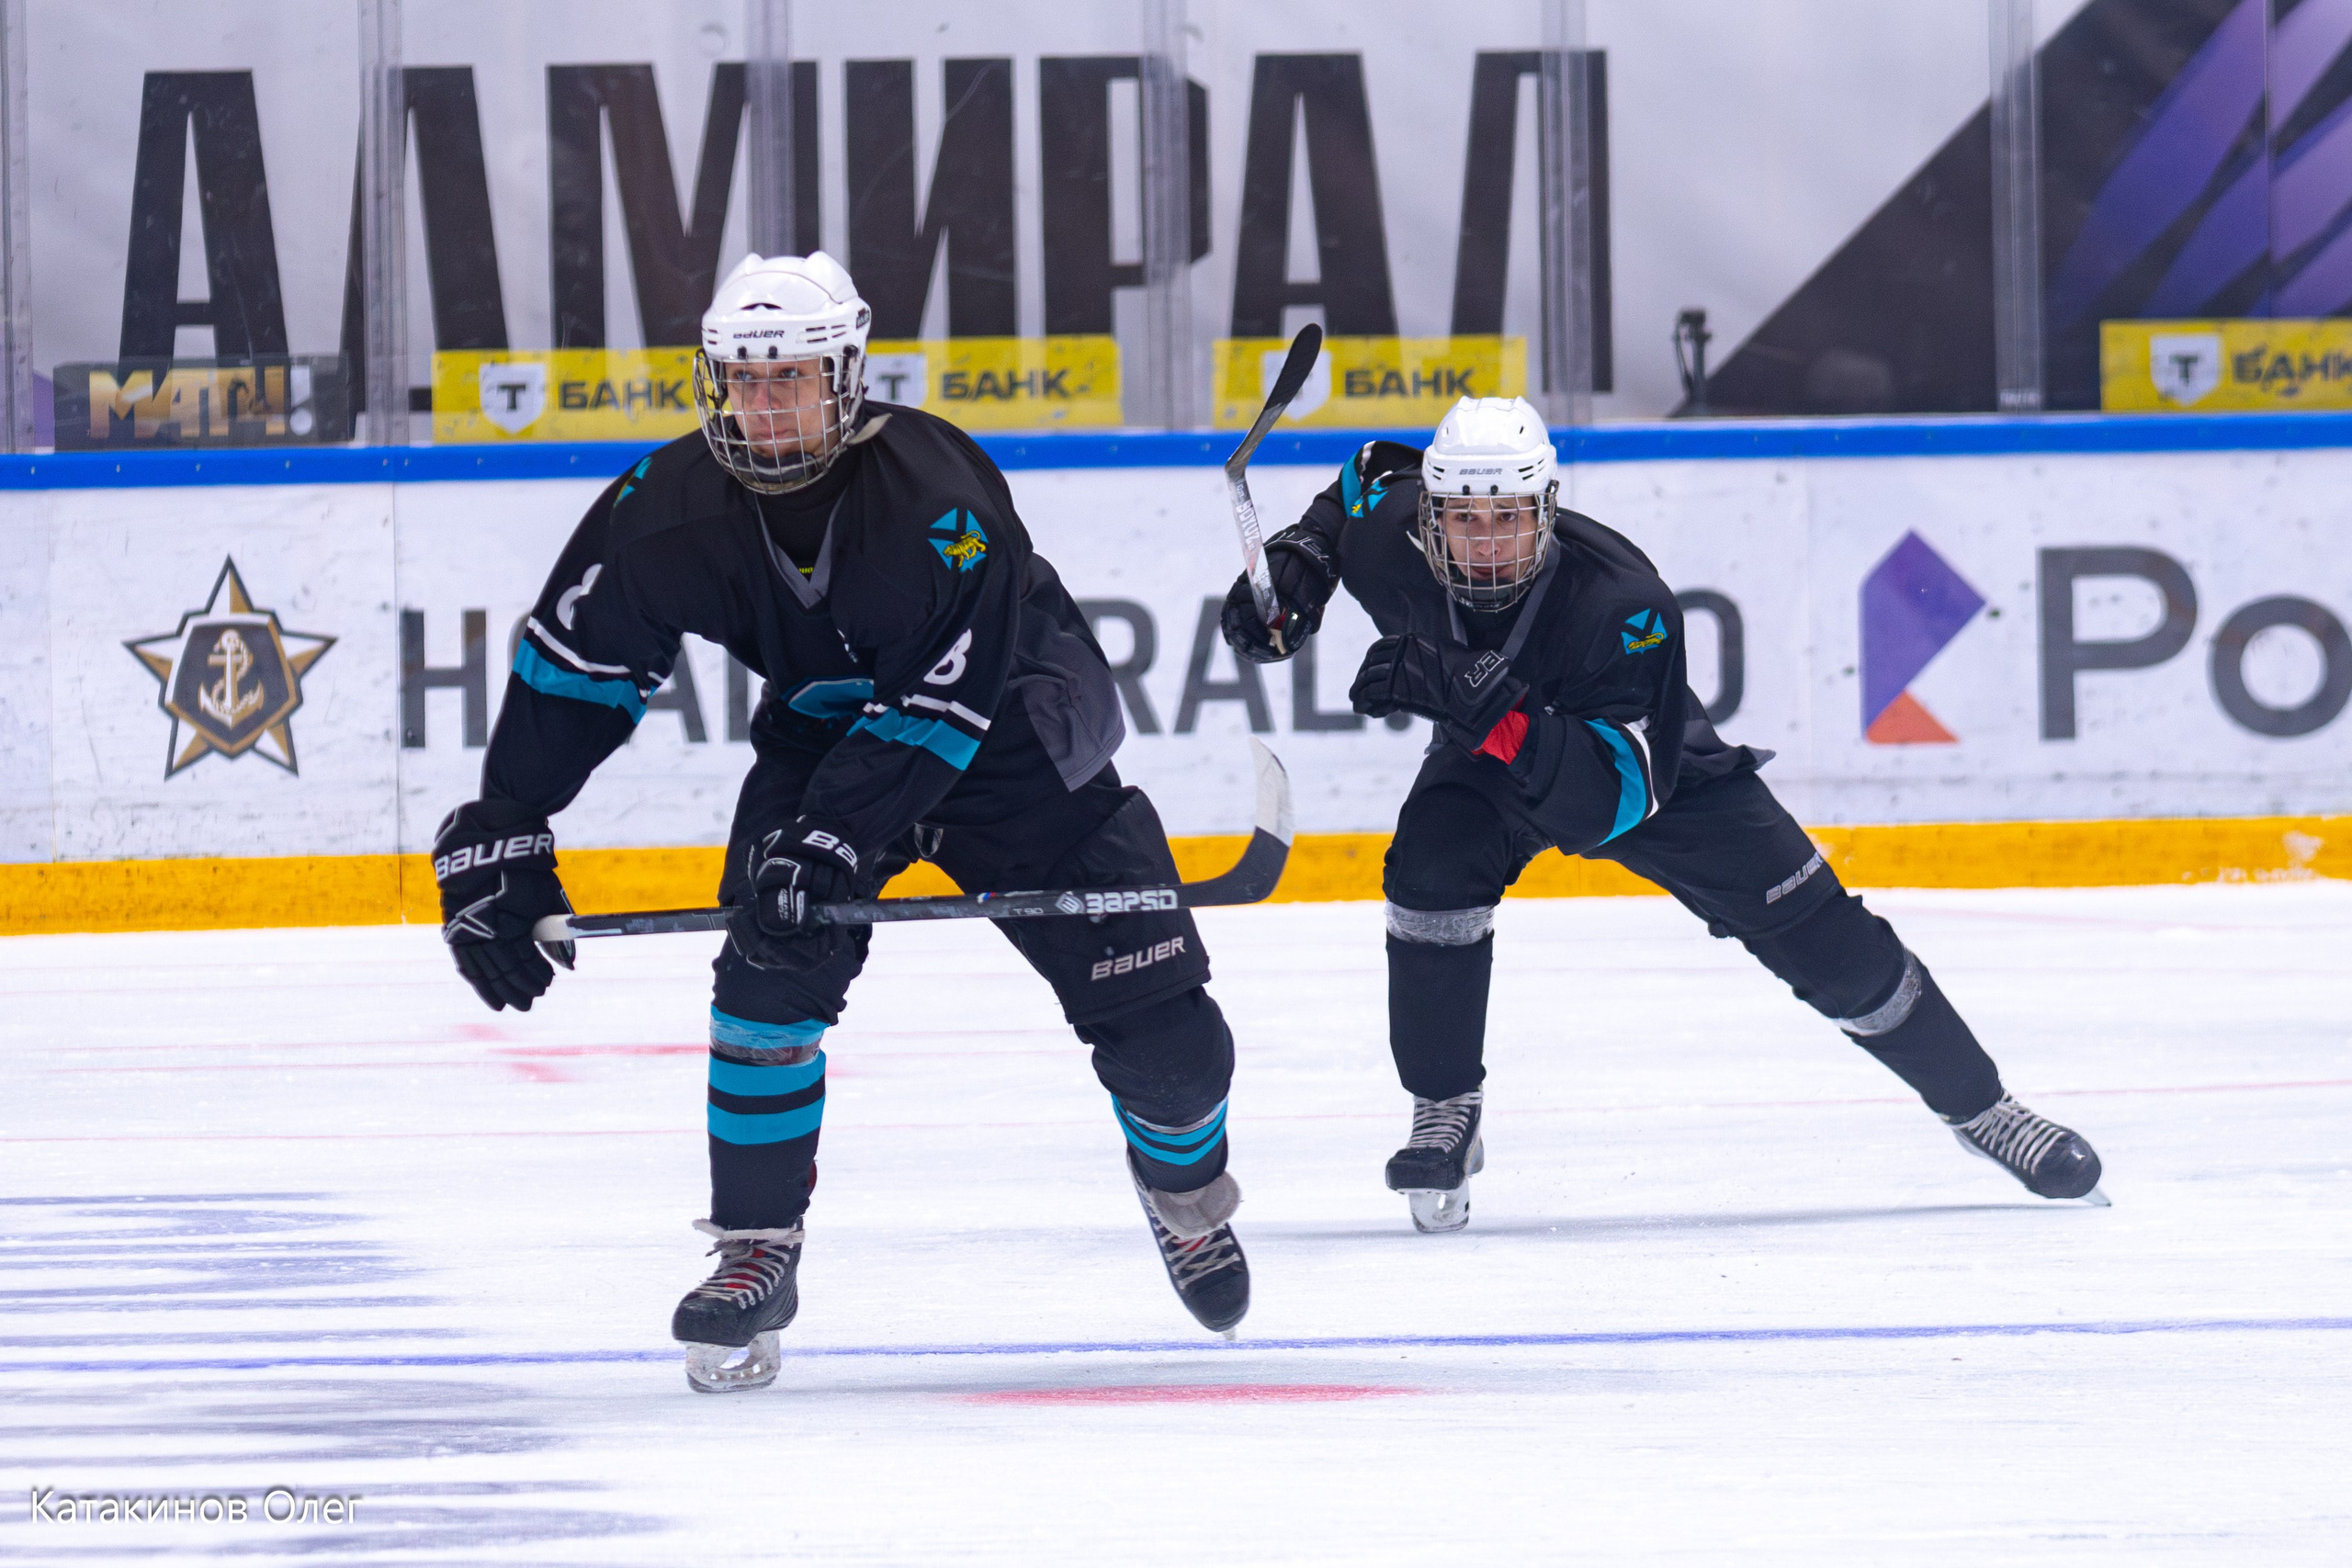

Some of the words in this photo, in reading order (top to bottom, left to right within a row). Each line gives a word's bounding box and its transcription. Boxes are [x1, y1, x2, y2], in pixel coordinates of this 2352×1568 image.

[118, 51, 1613, 439] АДМИРАЛ
[560, 378, 688, 411] БАНК
[942, 369, 1071, 400] БАНК
[1344, 367, 1475, 399] БАНК
[434, 833, 553, 883] BAUER
[1091, 935, 1186, 982] BAUER
